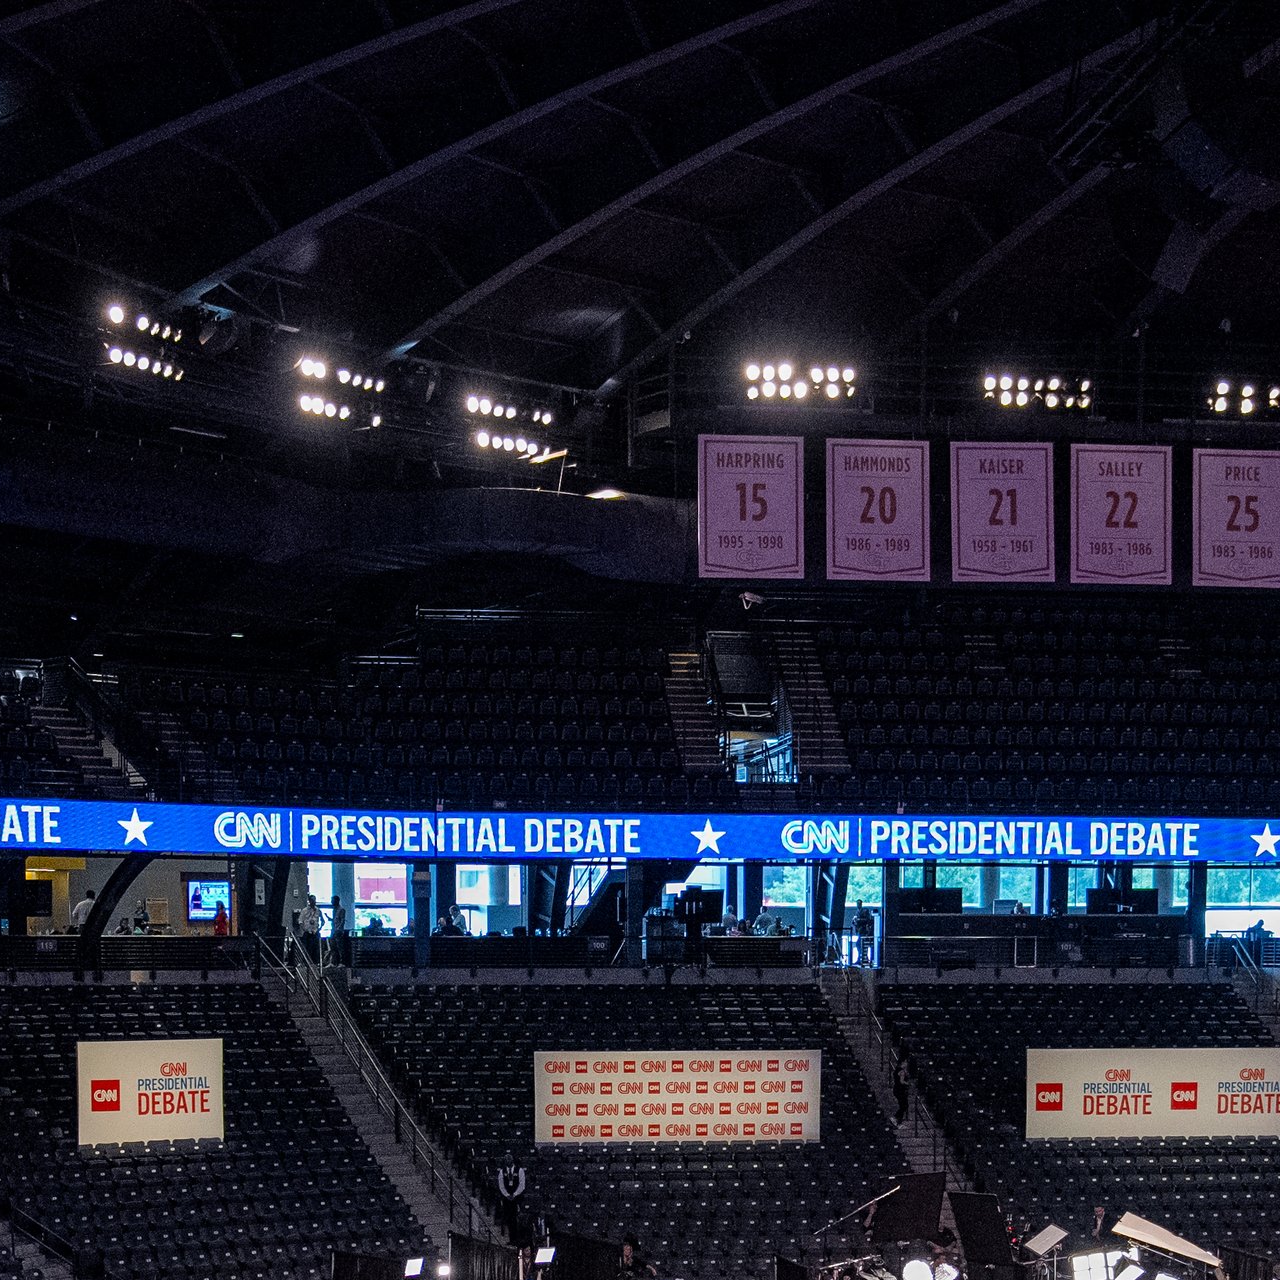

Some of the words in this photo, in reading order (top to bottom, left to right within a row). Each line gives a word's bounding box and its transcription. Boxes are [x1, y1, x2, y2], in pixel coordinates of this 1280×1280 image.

[715, 451, 785, 470] HARPRING
[843, 455, 911, 474] HAMMONDS
[978, 458, 1025, 475] KAISER
[1097, 460, 1144, 478] SALLEY
[1224, 466, 1262, 483] PRICE
[735, 482, 769, 523] 15
[859, 486, 898, 525] 20
[988, 488, 1018, 527] 21
[1104, 490, 1139, 529] 22
[1225, 494, 1260, 533] 25
[717, 535, 743, 550] 1995
[757, 535, 784, 550] 1998
[846, 538, 871, 552] 1986
[885, 538, 910, 553] 1989
[972, 539, 998, 554] 1958
[1010, 539, 1034, 554] 1961
[1088, 541, 1114, 556] 1983
[1126, 542, 1152, 556] 1986
[1211, 544, 1236, 559] 1983
[1248, 546, 1274, 560] 1986
[213, 811, 282, 848] CNN
[301, 814, 516, 853] PRESIDENTIAL
[524, 818, 641, 853] DEBATE
[781, 820, 850, 854] CNN
[870, 820, 1082, 855] PRESIDENTIAL
[1090, 822, 1200, 856] DEBATE
[160, 1062, 187, 1077] CNN
[1105, 1068, 1131, 1082] CNN
[1239, 1068, 1265, 1081] CNN
[137, 1076, 210, 1091] PRESIDENTIAL
[1083, 1082, 1152, 1094] PRESIDENTIAL
[93, 1089, 118, 1102] CNN
[137, 1089, 210, 1116] DEBATE
[1037, 1091, 1060, 1103] CNN
[1083, 1094, 1152, 1116] DEBATE
[1173, 1090, 1195, 1102] CNN
